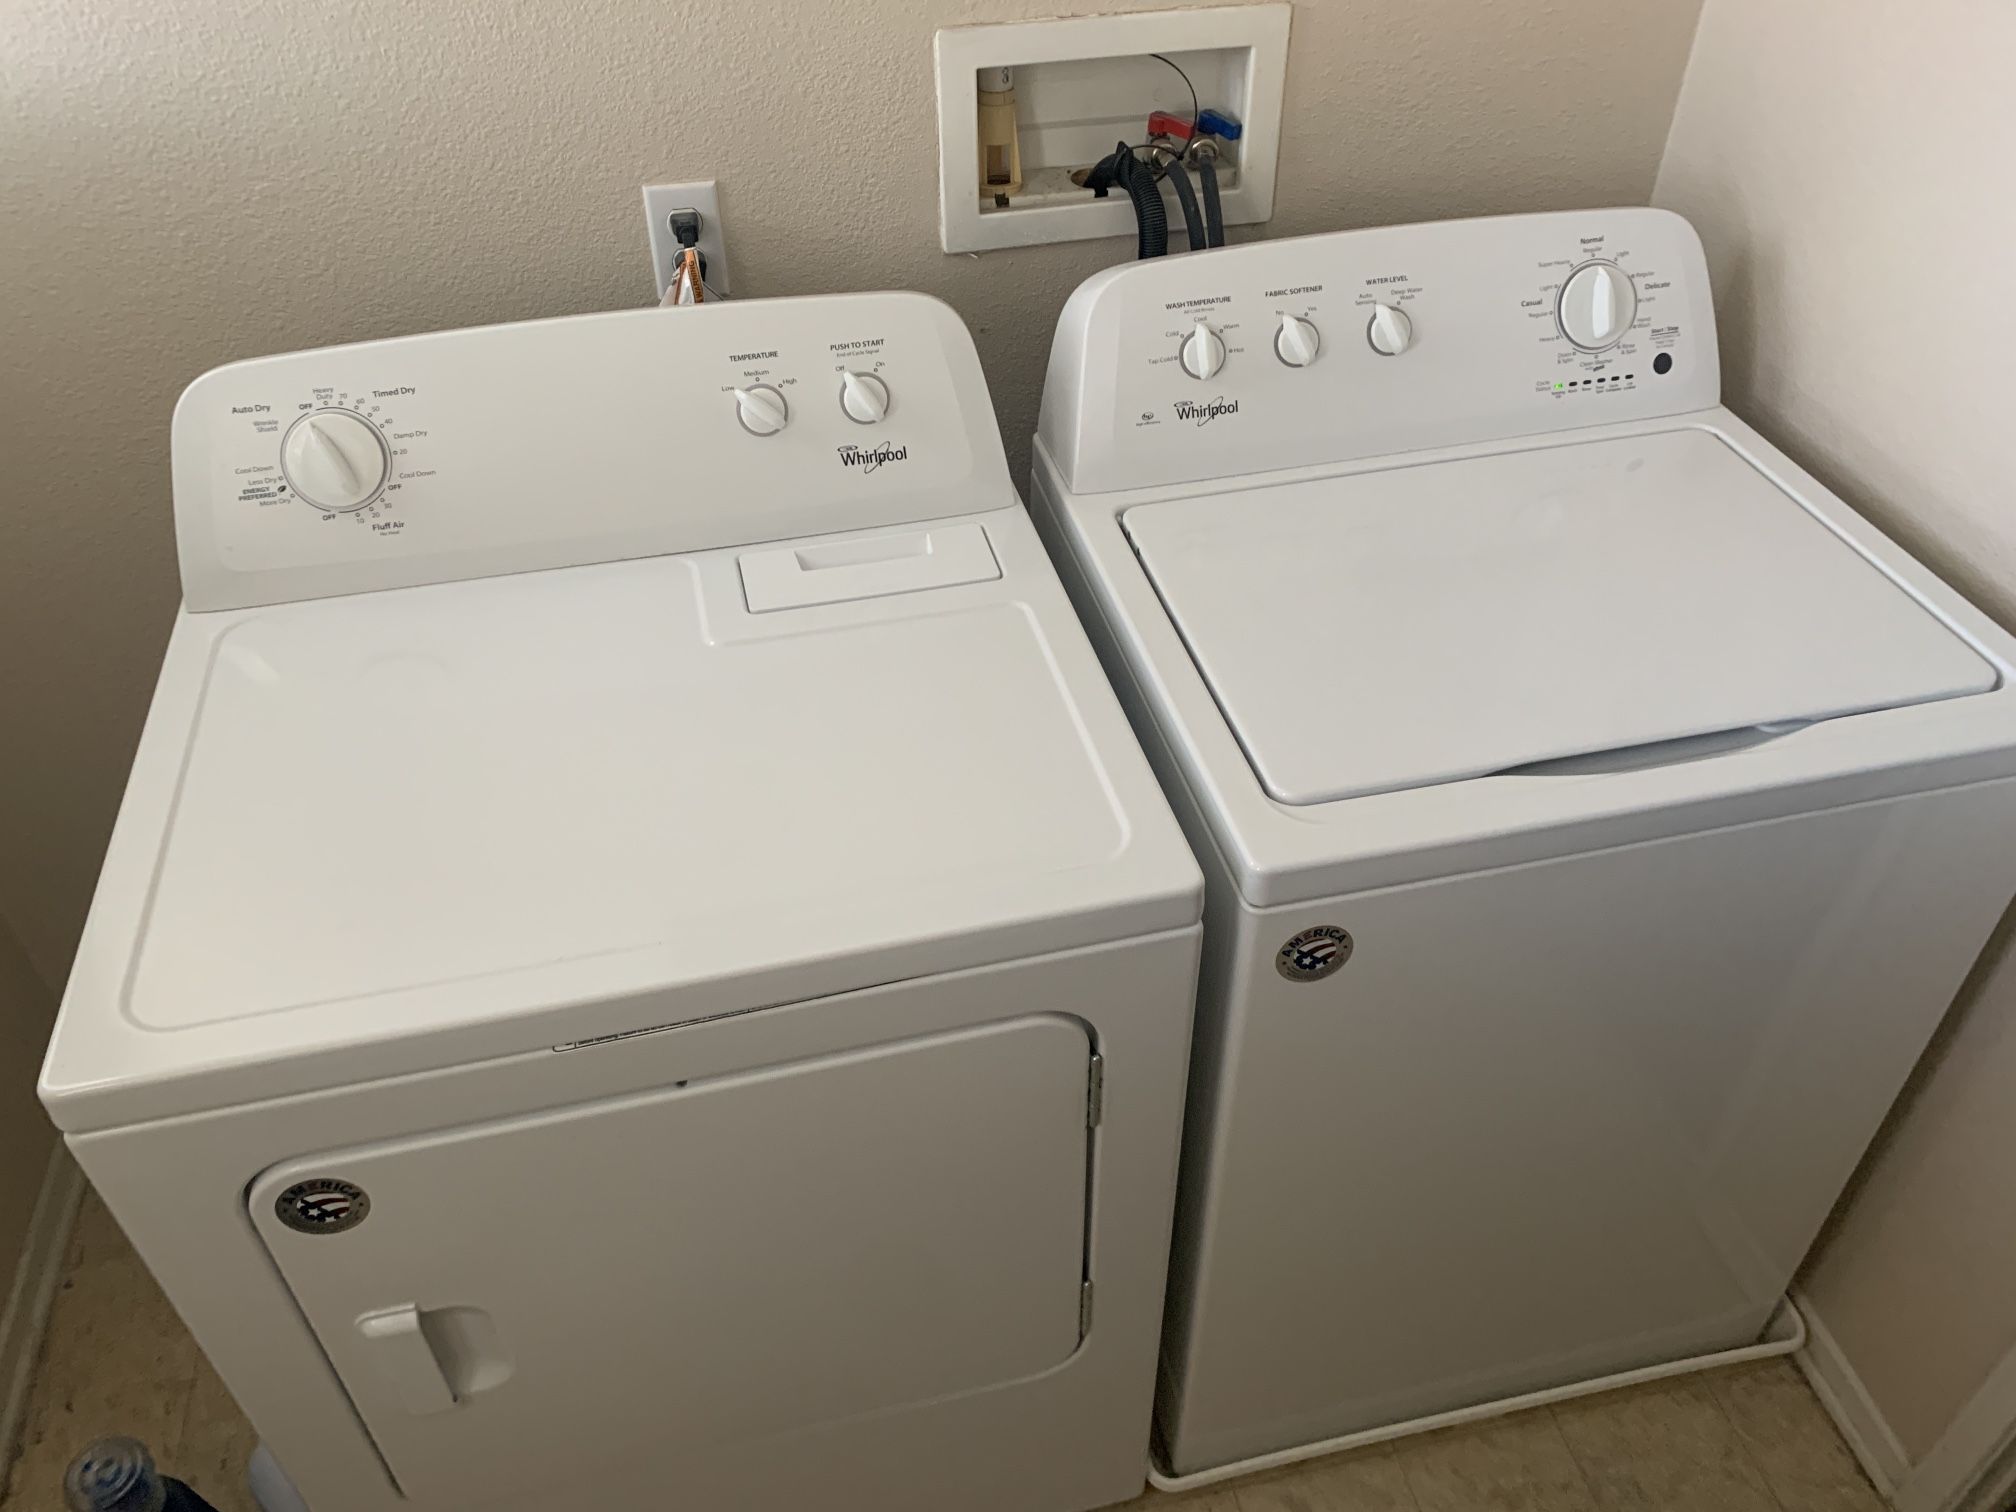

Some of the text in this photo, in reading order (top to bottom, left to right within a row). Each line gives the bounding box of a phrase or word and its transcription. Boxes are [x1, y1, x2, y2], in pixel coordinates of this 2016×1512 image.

[1366, 275, 1408, 285] WATER LEVEL
[1265, 285, 1322, 297] FABRIC SOFTENER
[1165, 296, 1231, 310] WASH TEMPERATURE
[1521, 298, 1543, 307] Casual
[830, 338, 884, 351] PUSH TO START
[729, 350, 779, 363] TEMPERATURE
[743, 368, 770, 377] Medium
[783, 377, 797, 386] High
[372, 386, 416, 398] Timed Dry
[232, 404, 271, 414] Auto Dry
[1177, 400, 1239, 420] Whirlpool
[394, 429, 428, 440] Damp Dry
[840, 445, 907, 467] Whirlpool
[416, 469, 436, 477] Down
[242, 486, 270, 495] ENERGY
[372, 520, 405, 531] Fluff Air
[1282, 928, 1347, 957] AMERICA
